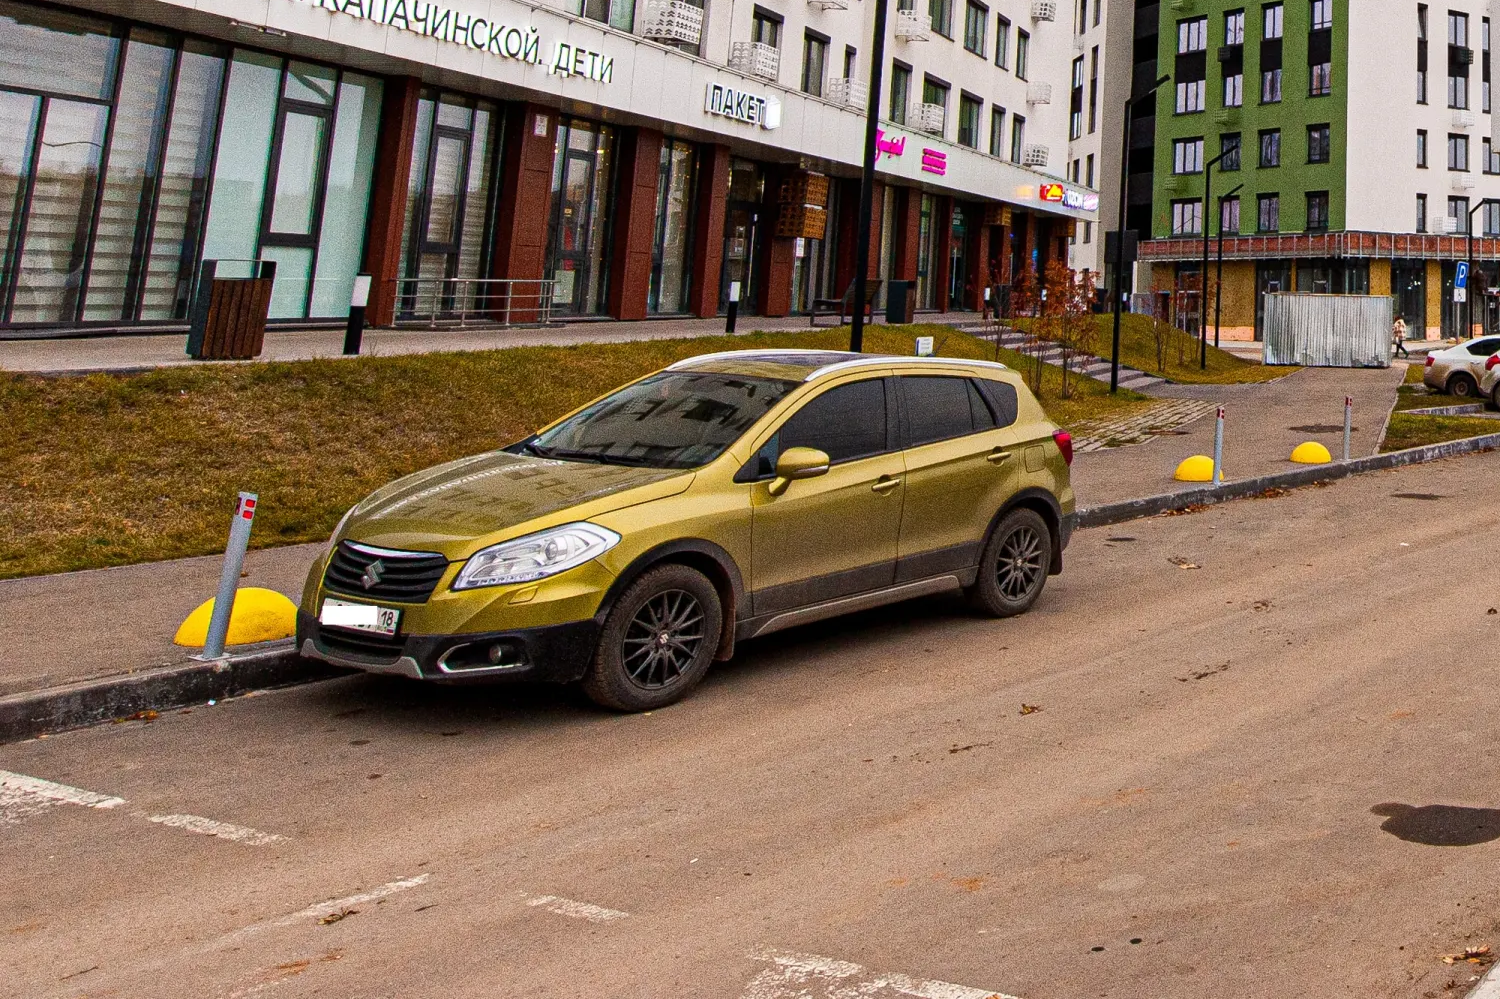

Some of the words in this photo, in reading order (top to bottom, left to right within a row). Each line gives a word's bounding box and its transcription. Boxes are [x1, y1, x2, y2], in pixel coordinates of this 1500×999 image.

[553, 42, 614, 84] ДЕТИ
[710, 84, 765, 123] ПАКЕТ
[381, 610, 394, 627] 18
